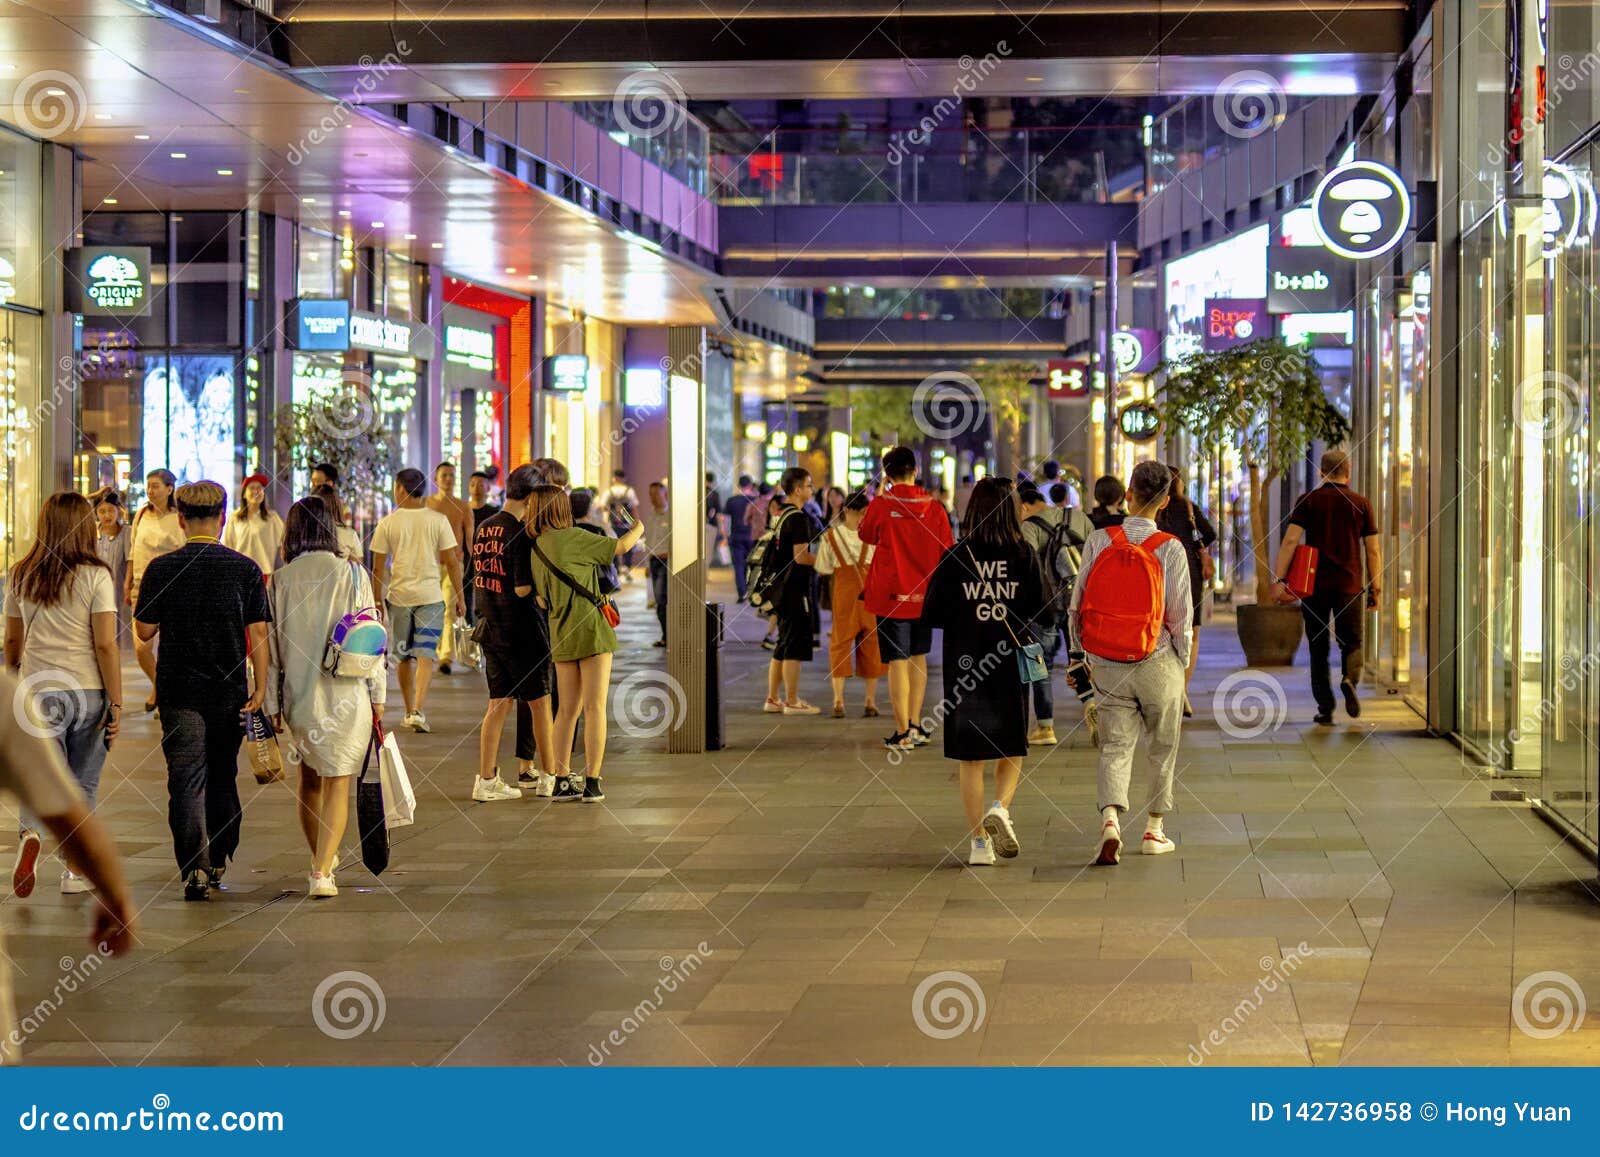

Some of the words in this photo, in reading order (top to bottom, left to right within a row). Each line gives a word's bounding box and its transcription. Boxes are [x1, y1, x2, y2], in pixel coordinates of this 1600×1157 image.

[1274, 270, 1329, 290] b+ab
[88, 287, 143, 298] ORIGINS
[1210, 309, 1256, 325] Super
[1210, 322, 1236, 341] Dry
[478, 526, 505, 538] ANTI
[975, 560, 1008, 579] WE
[475, 576, 503, 593] CLUB
[962, 581, 1020, 601] WANT
[976, 602, 1008, 622] GO
